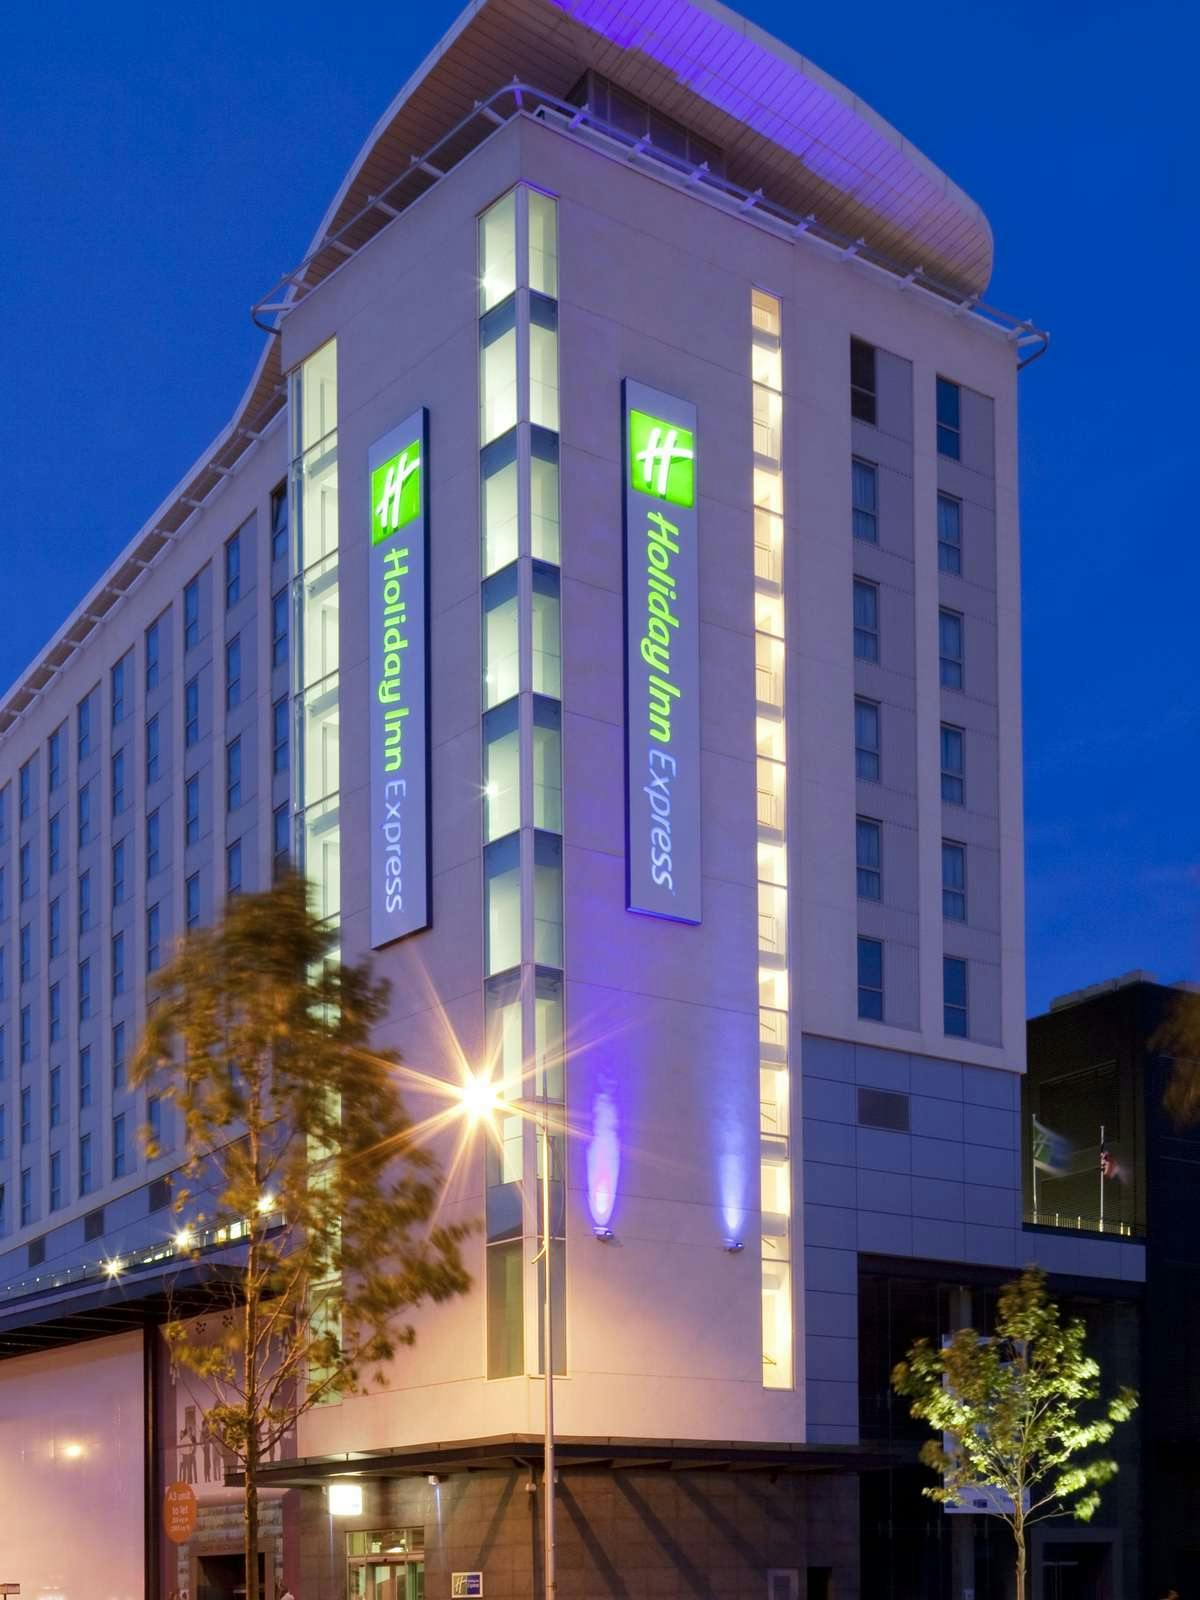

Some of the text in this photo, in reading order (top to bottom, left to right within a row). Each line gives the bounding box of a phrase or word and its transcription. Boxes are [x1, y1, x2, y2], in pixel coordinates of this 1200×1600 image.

[378, 548, 410, 913] Holiday Inn Express
[640, 511, 681, 890] Holiday Inn Express
